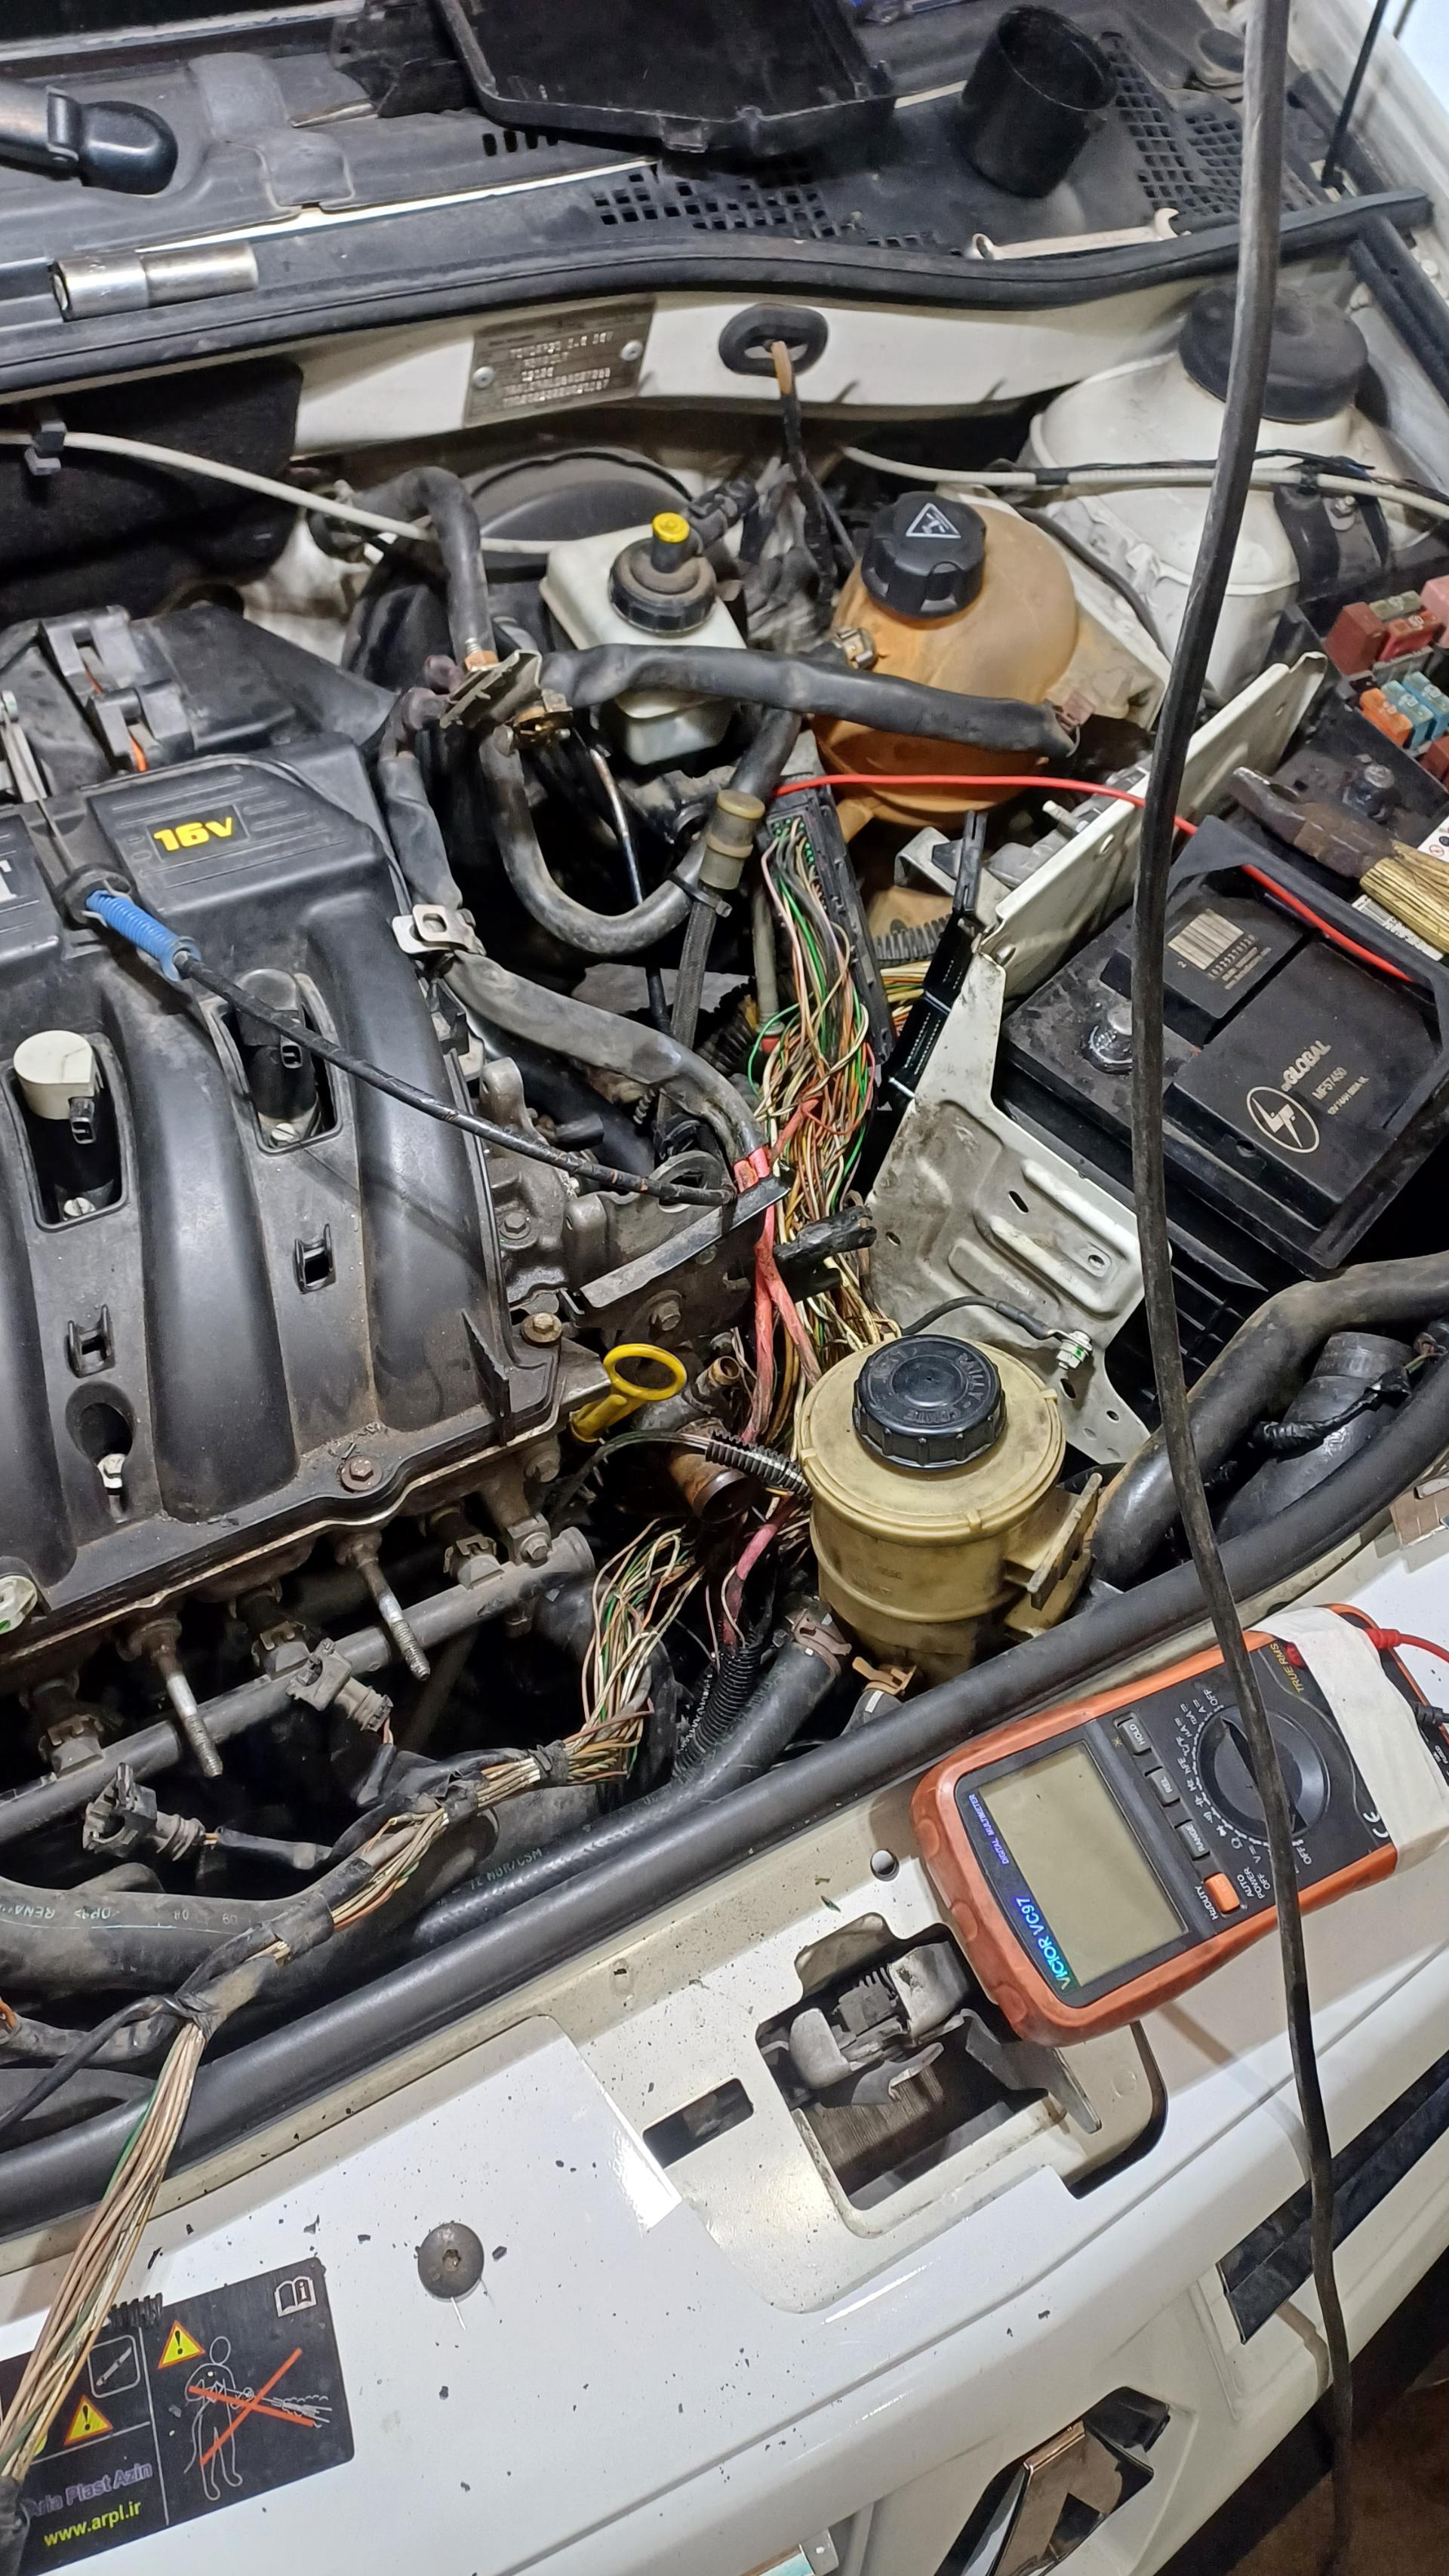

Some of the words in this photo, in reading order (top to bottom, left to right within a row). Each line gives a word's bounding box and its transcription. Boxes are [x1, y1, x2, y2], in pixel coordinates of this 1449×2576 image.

[153, 816, 234, 852] 16V
[1270, 1643, 1287, 1665] RMS
[1282, 1665, 1305, 1693] TRUE
[1204, 1688, 1219, 1706] OFF
[1128, 1723, 1146, 1745] HOLD
[1158, 1775, 1174, 1795] REL
[968, 1793, 995, 1835] MULTIMETER
[991, 1836, 1009, 1865] DIGITAL
[1184, 1823, 1206, 1852] RANGE
[1300, 1846, 1312, 1866] OFF
[1236, 1873, 1255, 1899] AUTO
[1243, 1867, 1265, 1900] POWER
[1256, 1873, 1271, 1890] OFF
[1016, 1896, 1045, 1936] VC97
[1195, 1885, 1220, 1920] Hz/DUTY
[1037, 1934, 1069, 1991] VICTOR
[65, 2474, 112, 2507] Plast
[113, 2463, 153, 2490] Azin
[42, 2500, 142, 2547] www.arpl.ir
